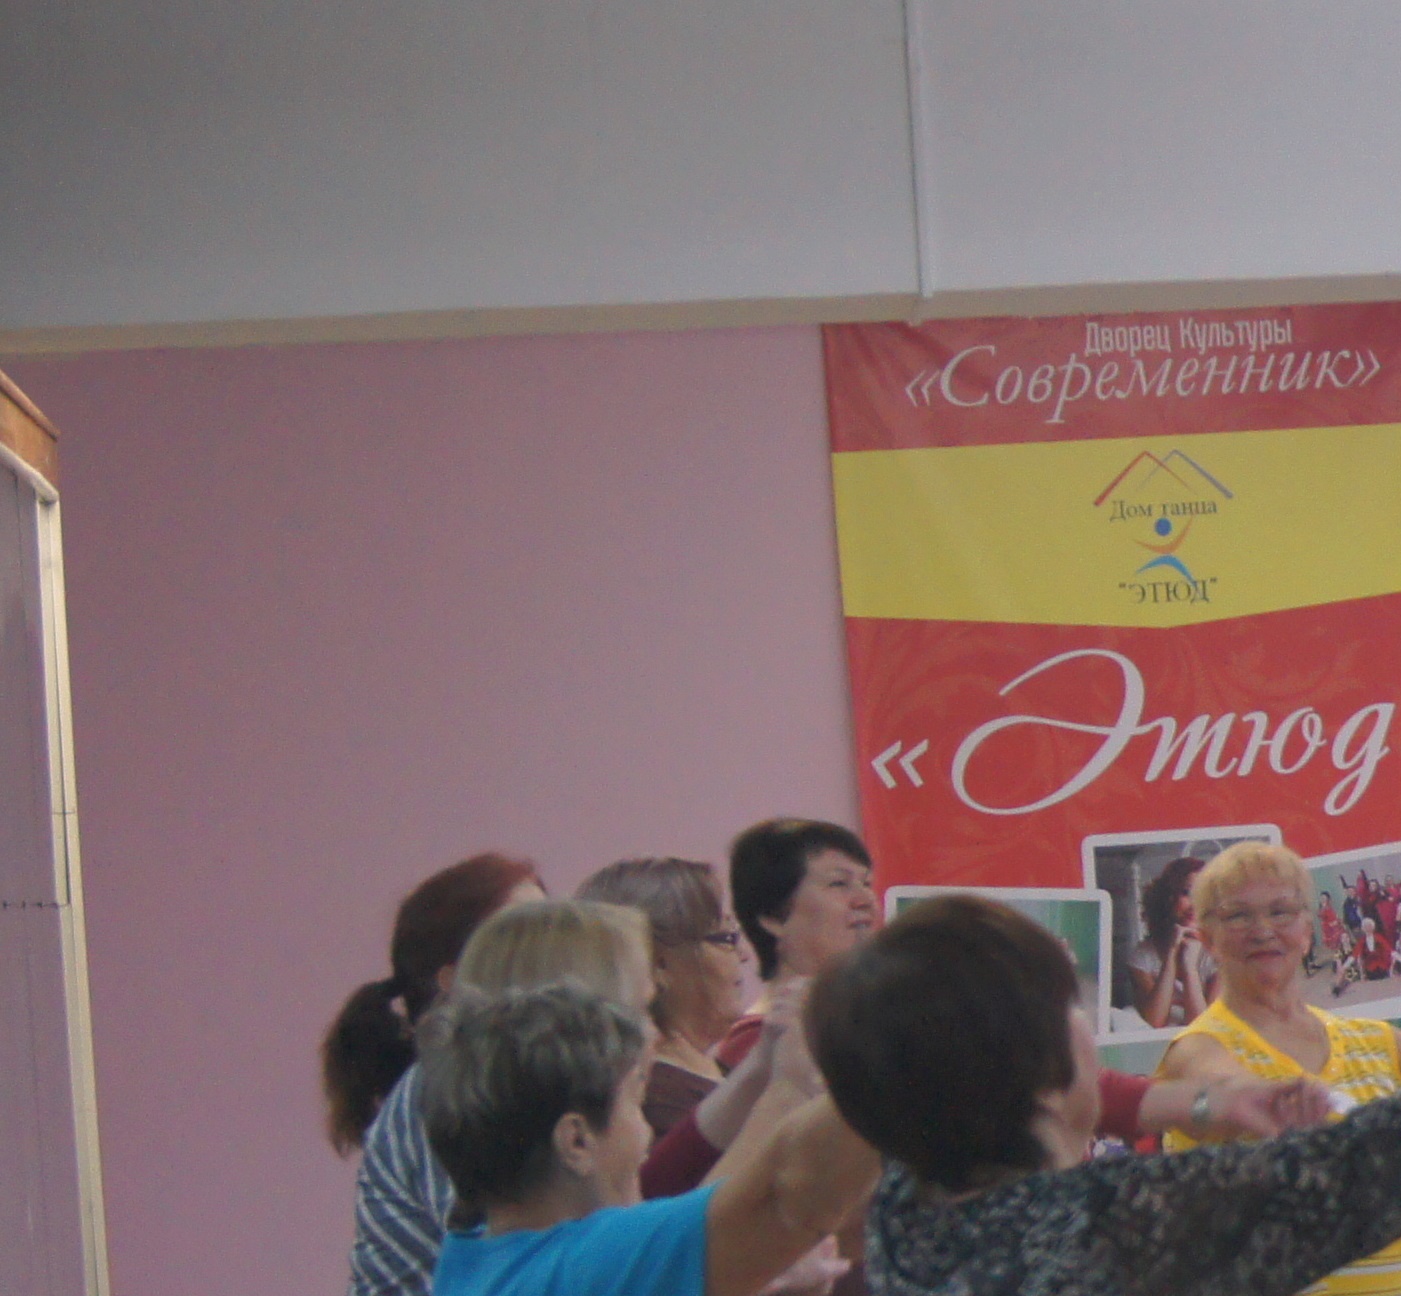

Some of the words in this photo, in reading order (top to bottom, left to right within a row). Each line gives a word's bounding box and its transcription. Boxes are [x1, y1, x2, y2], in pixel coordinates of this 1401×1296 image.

[1084, 320, 1172, 357] Дворец
[1179, 317, 1293, 355] Культуры
[904, 344, 1382, 425] «Современник»
[1109, 500, 1153, 522] Дом
[1162, 500, 1218, 517] танца
